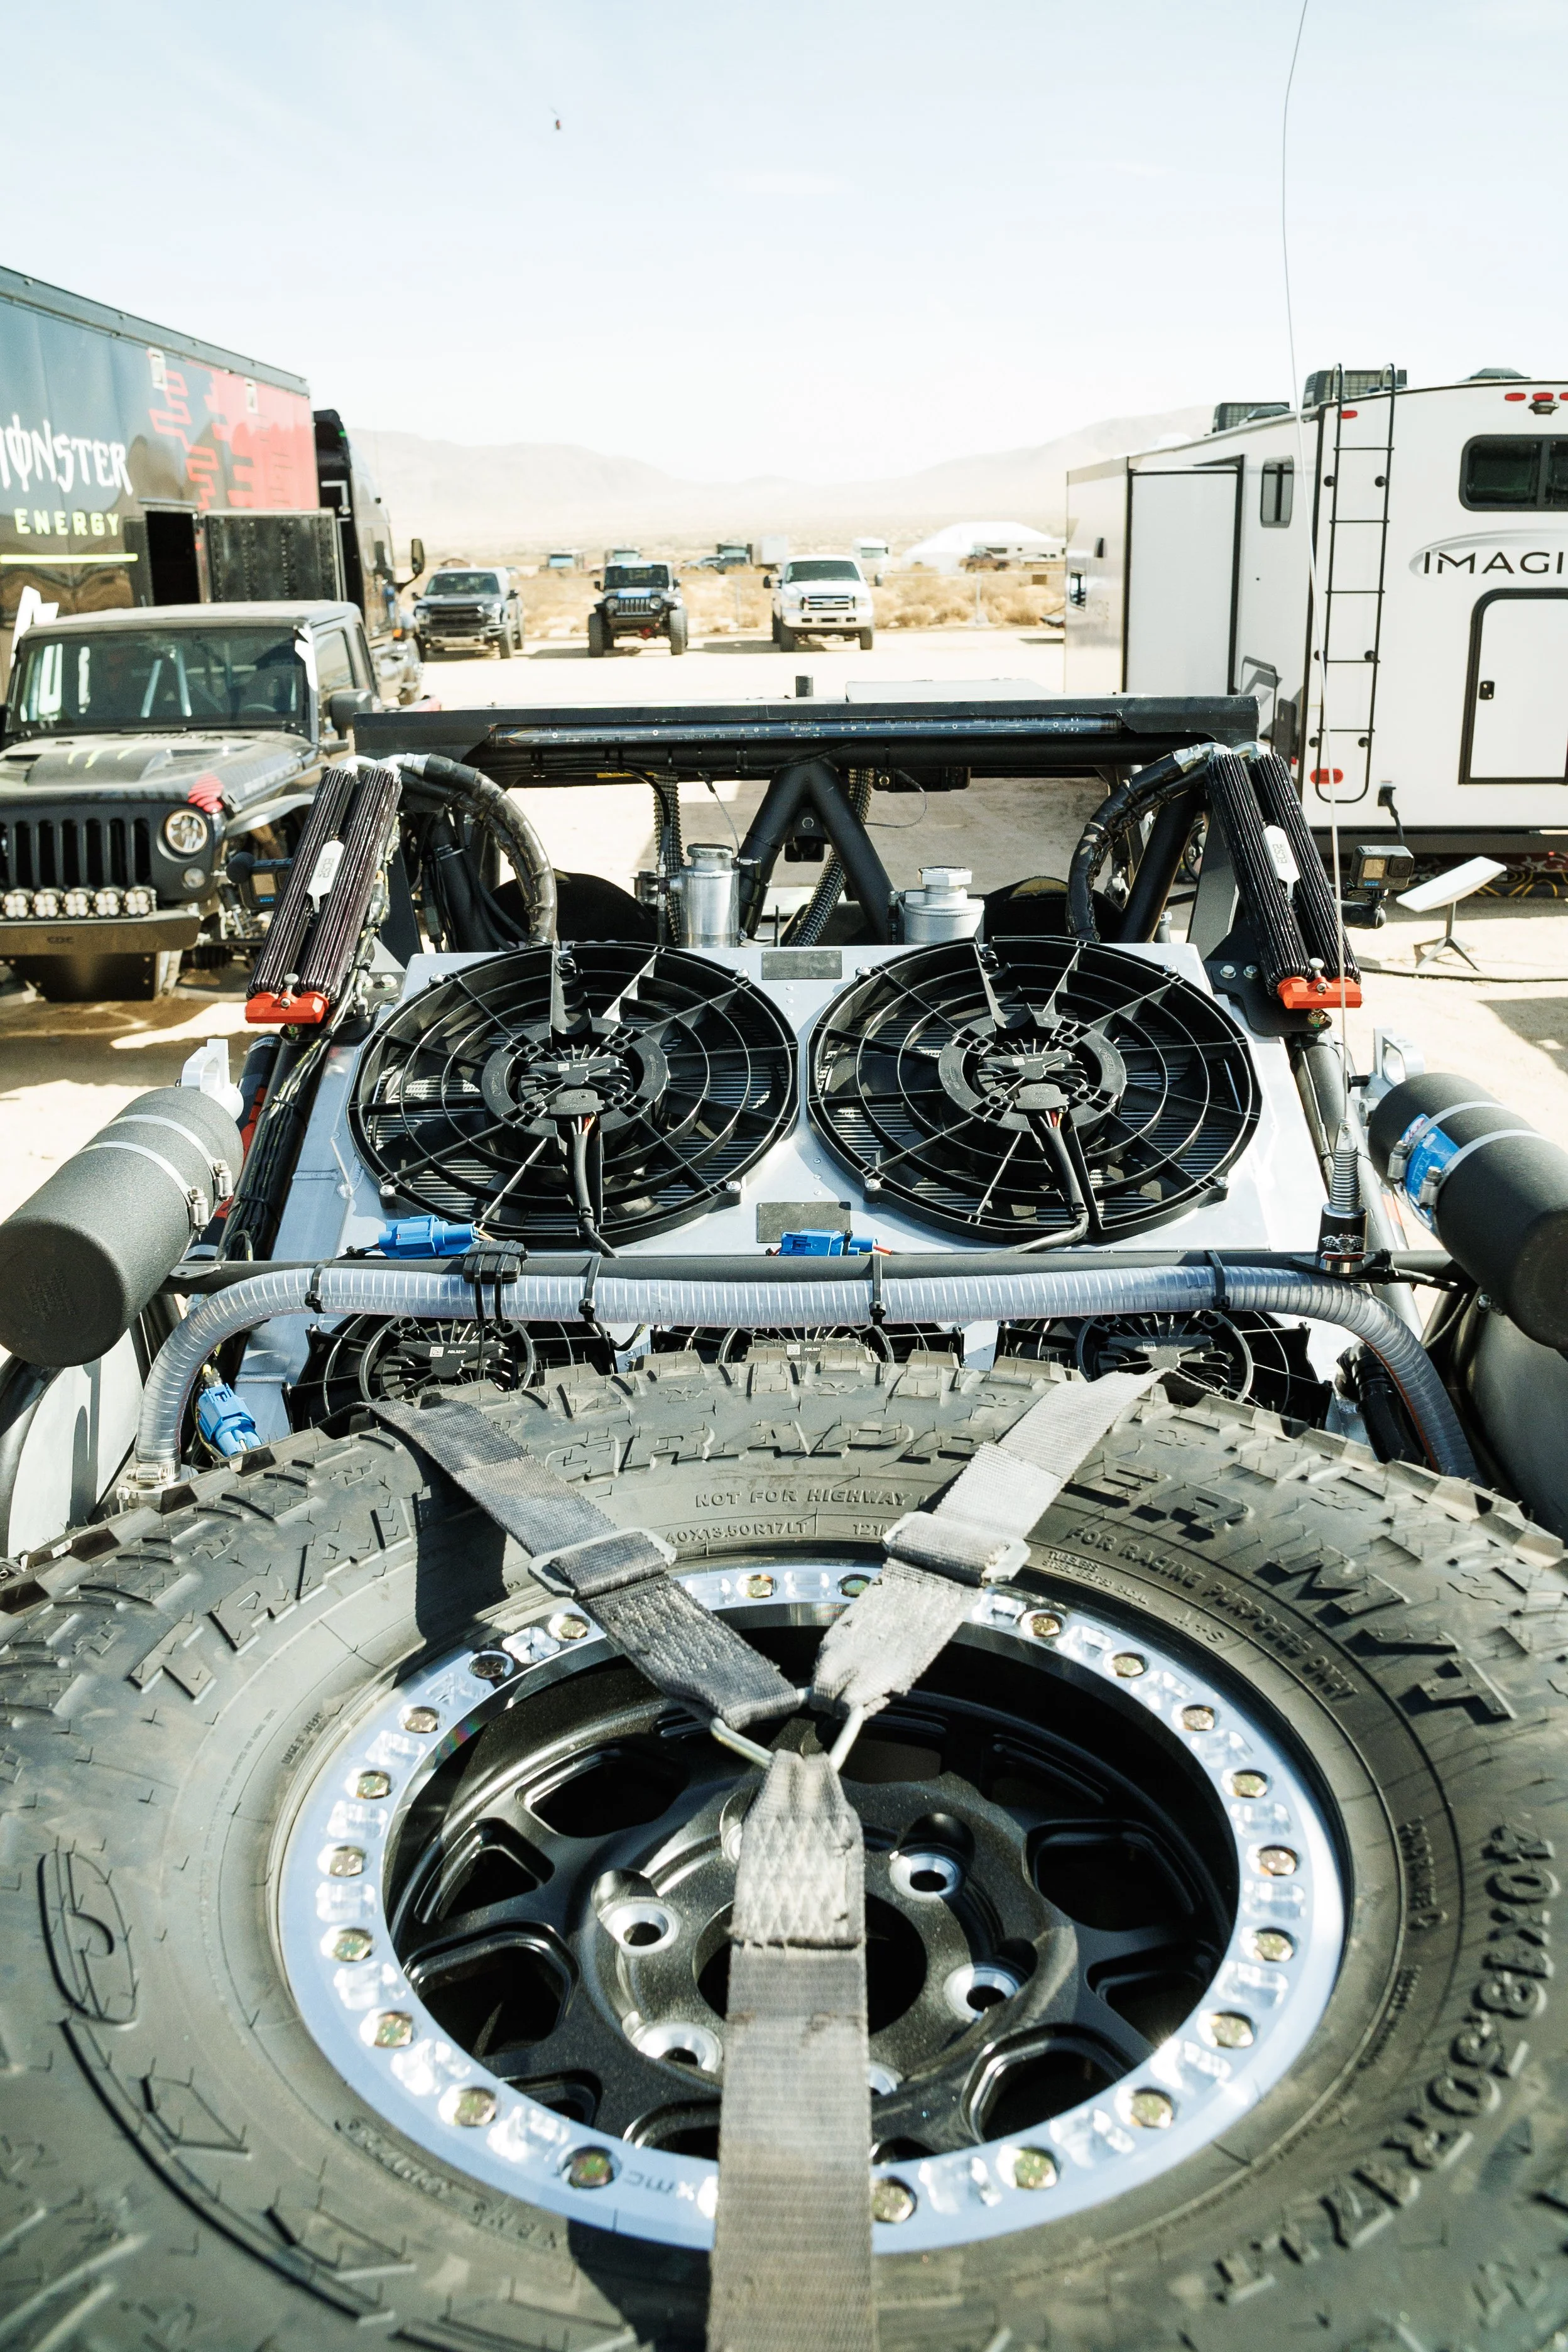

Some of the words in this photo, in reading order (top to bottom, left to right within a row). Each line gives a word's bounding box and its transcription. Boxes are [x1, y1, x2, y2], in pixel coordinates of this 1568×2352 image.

[14, 508, 119, 536] ENERGY
[1424, 551, 1564, 574] IMAGI
[695, 1490, 741, 1508] NOT
[750, 1488, 798, 1505] FOR
[807, 1487, 913, 1506] HIGHWAY
[1064, 1527, 1117, 1552] FOR
[1118, 1542, 1206, 1589] RACING
